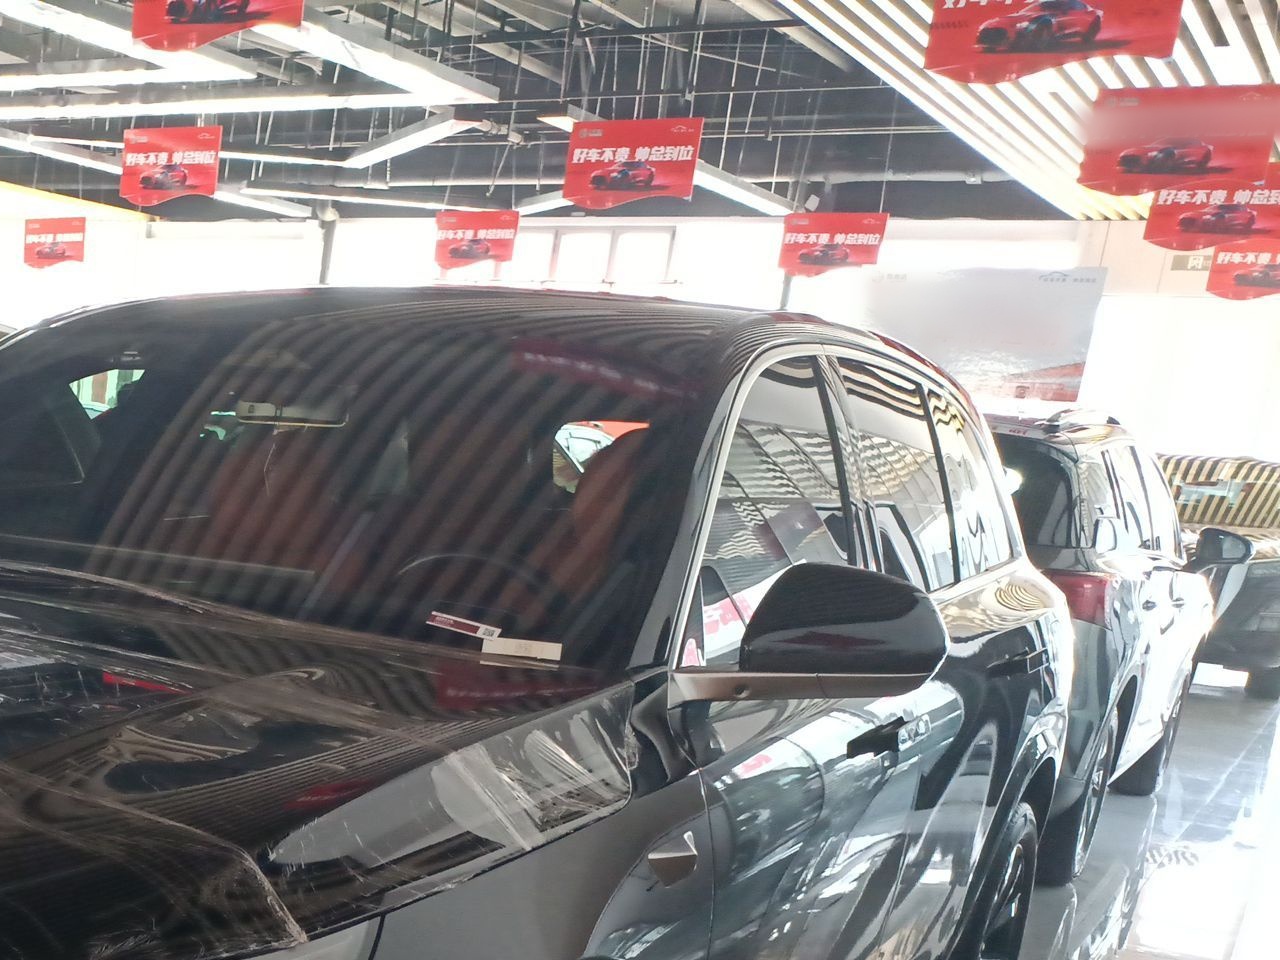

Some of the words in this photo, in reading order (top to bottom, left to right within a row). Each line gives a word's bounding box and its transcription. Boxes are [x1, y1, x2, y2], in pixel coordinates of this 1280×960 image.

[125, 152, 168, 166] 好车不贵
[572, 147, 630, 163] 好车不贵
[634, 145, 695, 162] 帅总到位
[1157, 189, 1227, 205] 好车不贵
